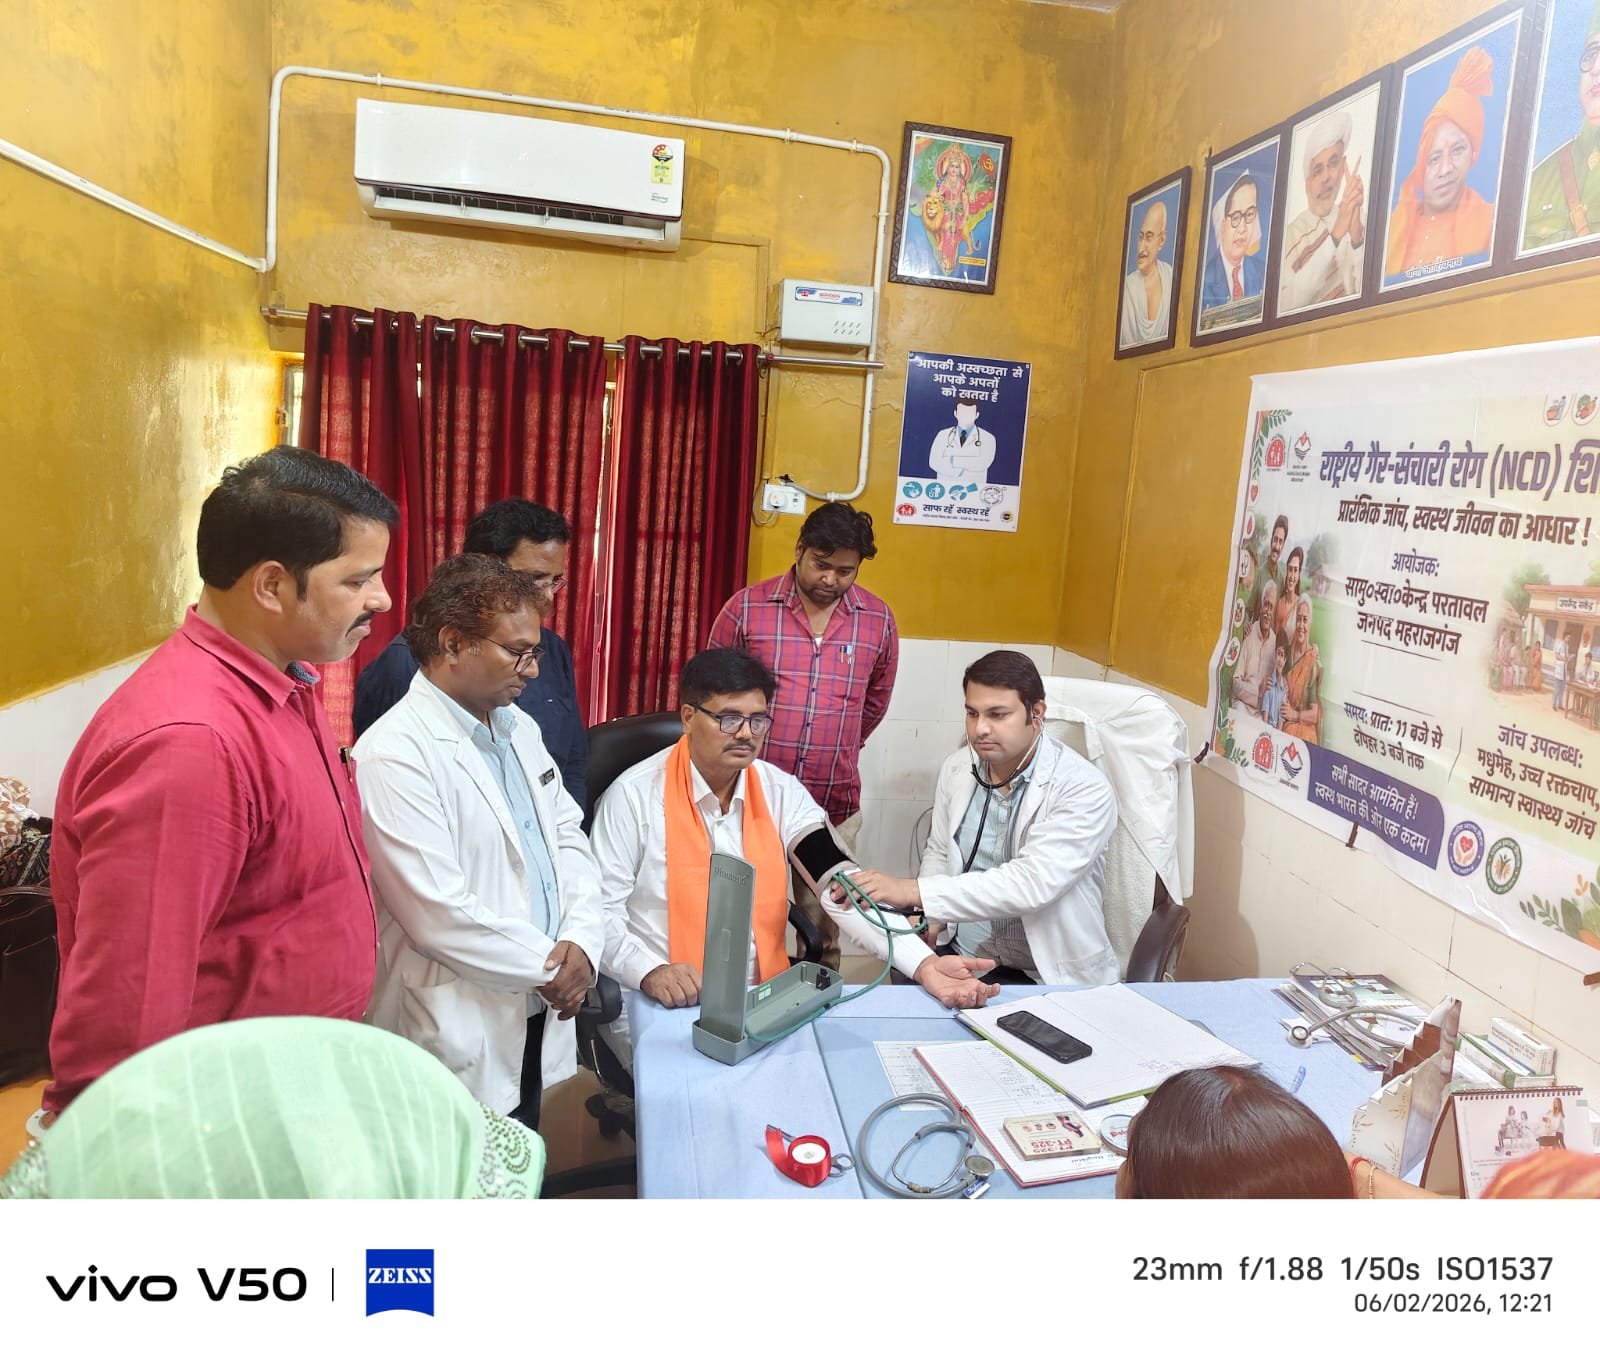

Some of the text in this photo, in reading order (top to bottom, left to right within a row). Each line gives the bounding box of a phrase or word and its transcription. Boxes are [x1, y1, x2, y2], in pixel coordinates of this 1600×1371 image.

[917, 359, 1024, 378] आपकी अस्वच्छता से
[933, 373, 1000, 389] आपके अपनों
[941, 385, 999, 402] को खतरा है
[1319, 440, 1366, 489] राष्ट्रीय
[1364, 439, 1450, 487] गैर-संचारी
[1450, 439, 1489, 489] रोग
[1490, 443, 1561, 501] (NCD)
[923, 504, 991, 516] साफ रहें स्वस्थ रहें
[1337, 493, 1383, 525] प्रारंभिक
[1382, 497, 1410, 532] जांच,
[1412, 505, 1454, 532] स्वस्थ
[1453, 500, 1498, 537] जीवन
[1498, 511, 1522, 539] का
[1522, 514, 1580, 545] आधार
[1431, 591, 1490, 623] परतावल
[1356, 611, 1462, 655] जनपद महराजगंज
[1353, 724, 1425, 771] दोपहर 3 बजे तक
[1396, 719, 1408, 738] 11
[1410, 720, 1430, 745] बजे
[1431, 725, 1444, 750] से
[1497, 723, 1528, 751] जांच
[1331, 764, 1349, 786] सभी
[1348, 773, 1369, 796] सादर
[1369, 784, 1407, 814] आमंत्रित
[1477, 748, 1600, 812] मधुमेह, उच्च रक्तचाप,
[1315, 782, 1336, 805] स्वस्थ
[1336, 791, 1358, 816] भारत
[1358, 799, 1369, 822] की
[1370, 805, 1384, 832] ओर
[1383, 817, 1401, 839] एक
[1469, 775, 1598, 841] सामान्य स्वास्थ्य जांच
